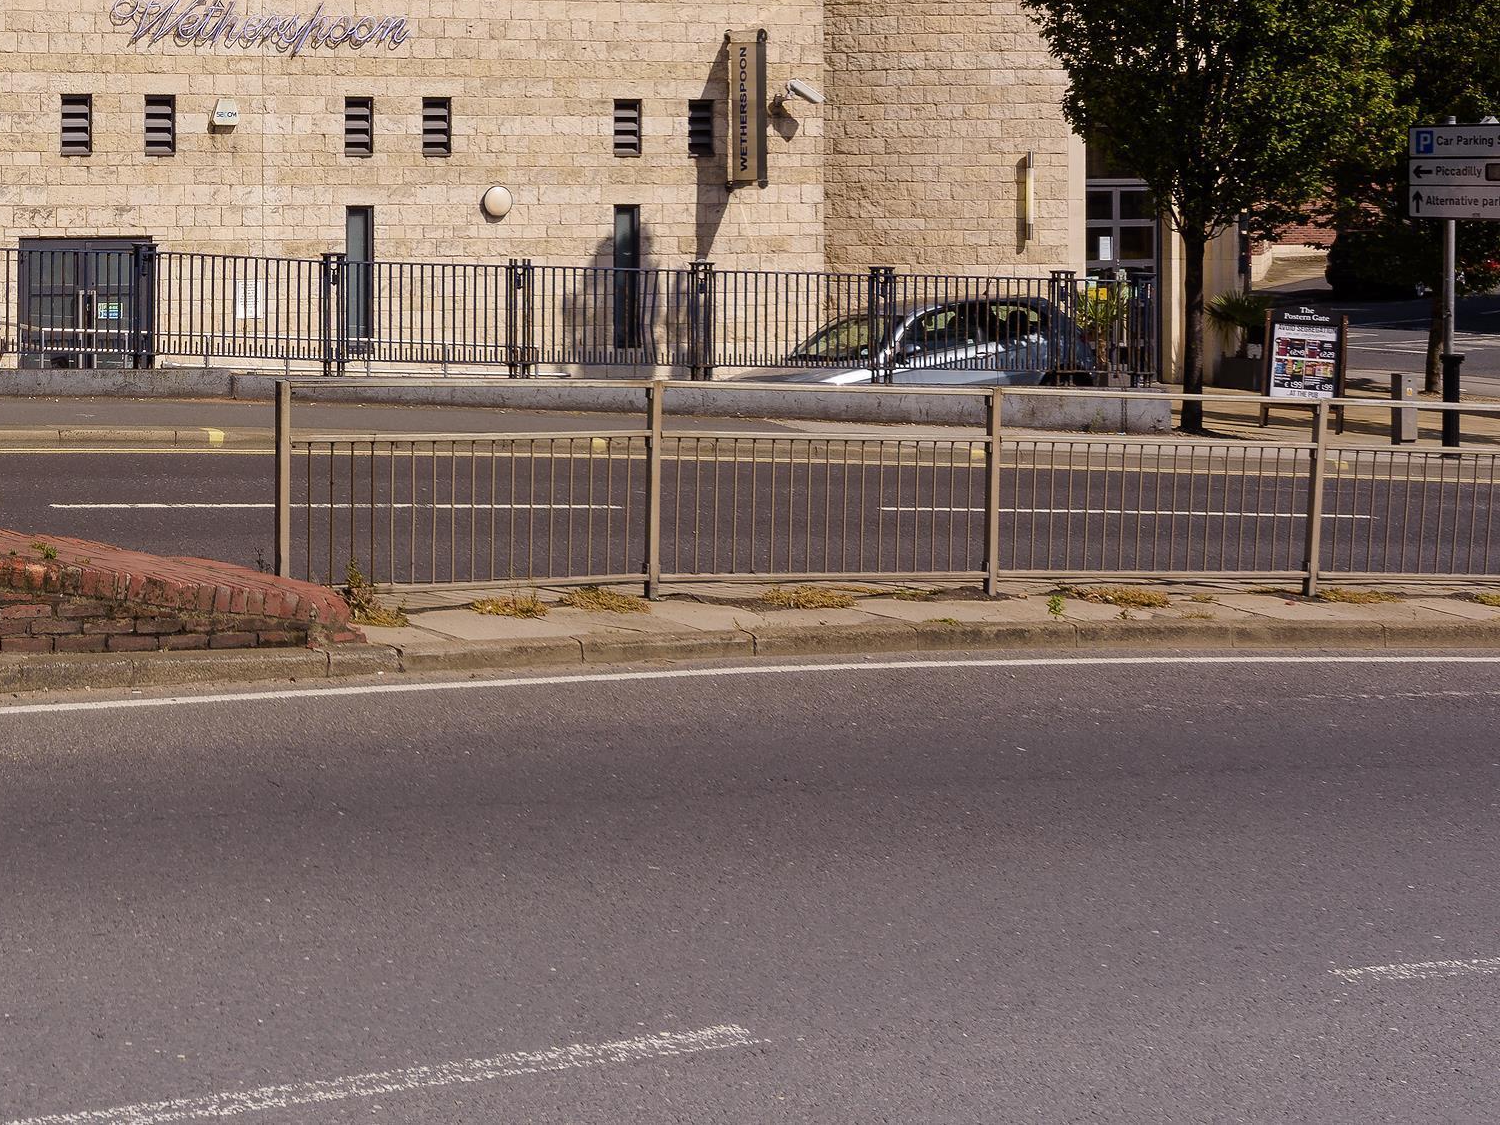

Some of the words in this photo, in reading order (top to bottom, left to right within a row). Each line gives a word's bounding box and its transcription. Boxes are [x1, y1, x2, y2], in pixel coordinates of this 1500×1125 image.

[739, 46, 748, 172] WETHERSPOON
[1420, 133, 1432, 152] P
[1436, 135, 1454, 146] Car
[1456, 135, 1494, 148] Parking
[1435, 165, 1483, 179] Piccadilly
[1425, 195, 1479, 206] Alternative
[1299, 306, 1315, 314] The
[1284, 312, 1311, 321] Postern
[1312, 314, 1330, 322] Gate
